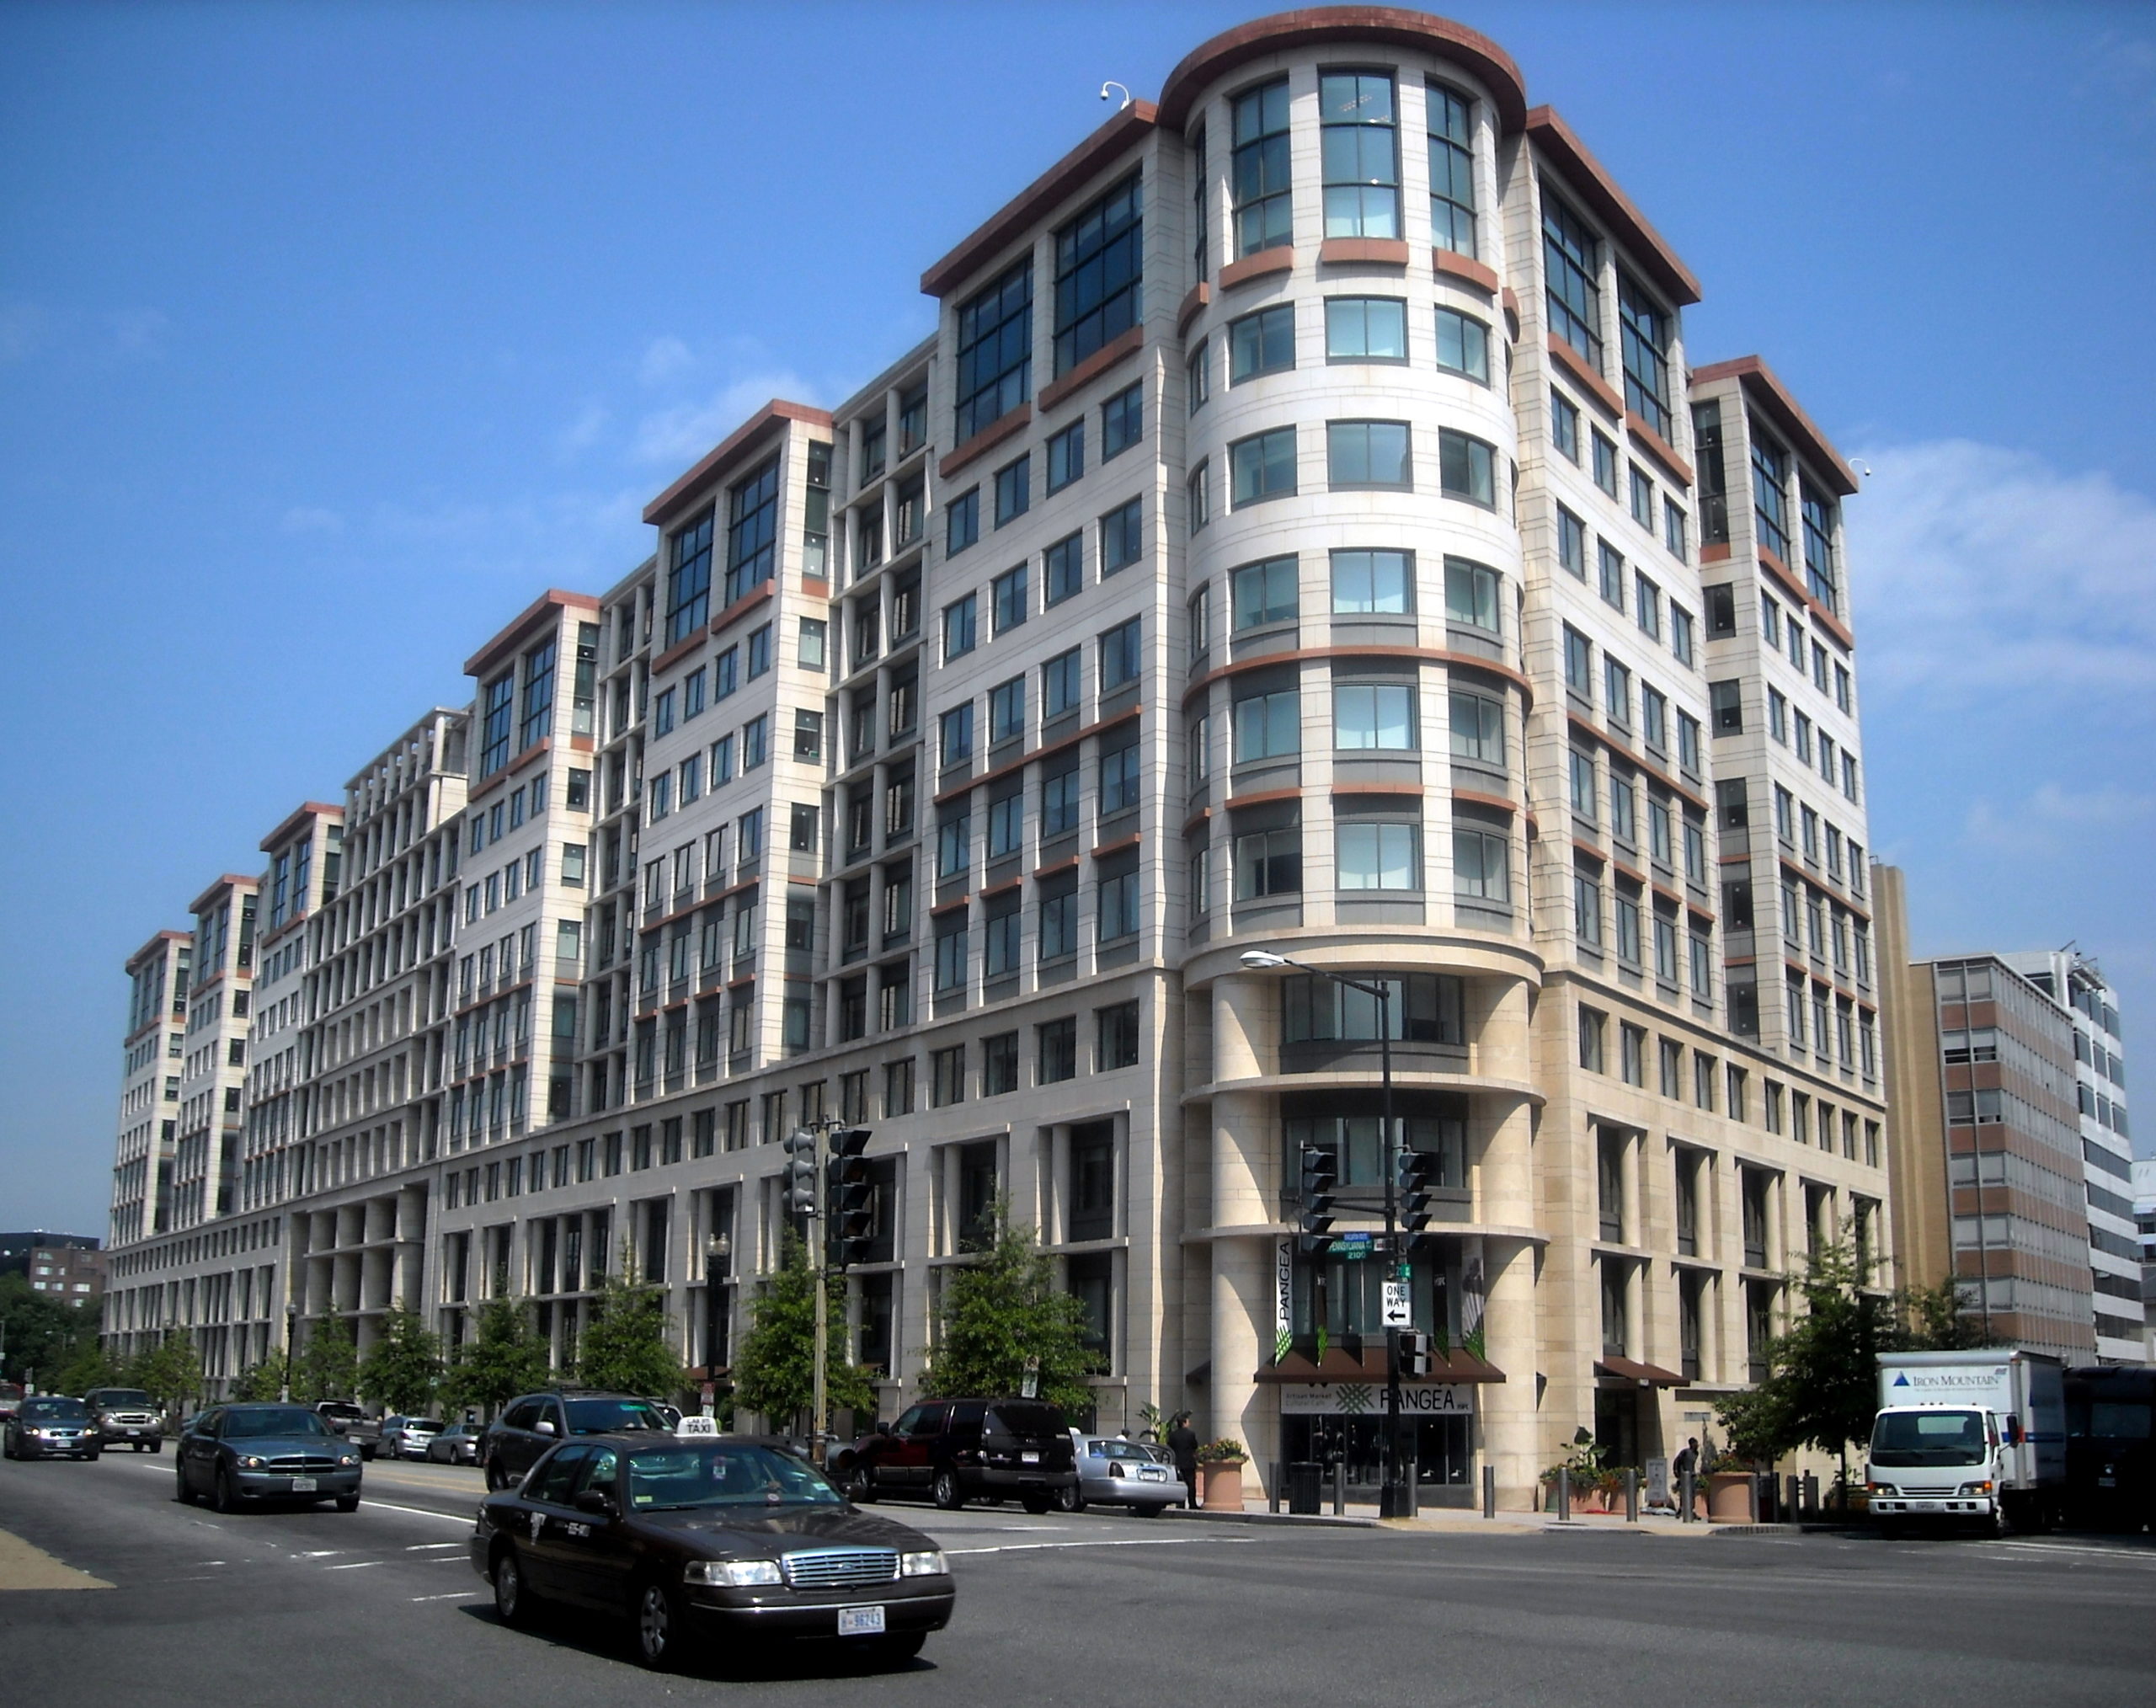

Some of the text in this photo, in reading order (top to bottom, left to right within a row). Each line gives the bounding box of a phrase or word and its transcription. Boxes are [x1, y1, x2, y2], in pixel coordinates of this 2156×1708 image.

[1279, 1242, 1290, 1320] PANGEA
[1386, 1285, 1406, 1296] ONE
[1386, 1297, 1406, 1307] WAY
[1913, 1374, 1999, 1386] IRON MOUNTAIN
[686, 1423, 711, 1433] TAXI
